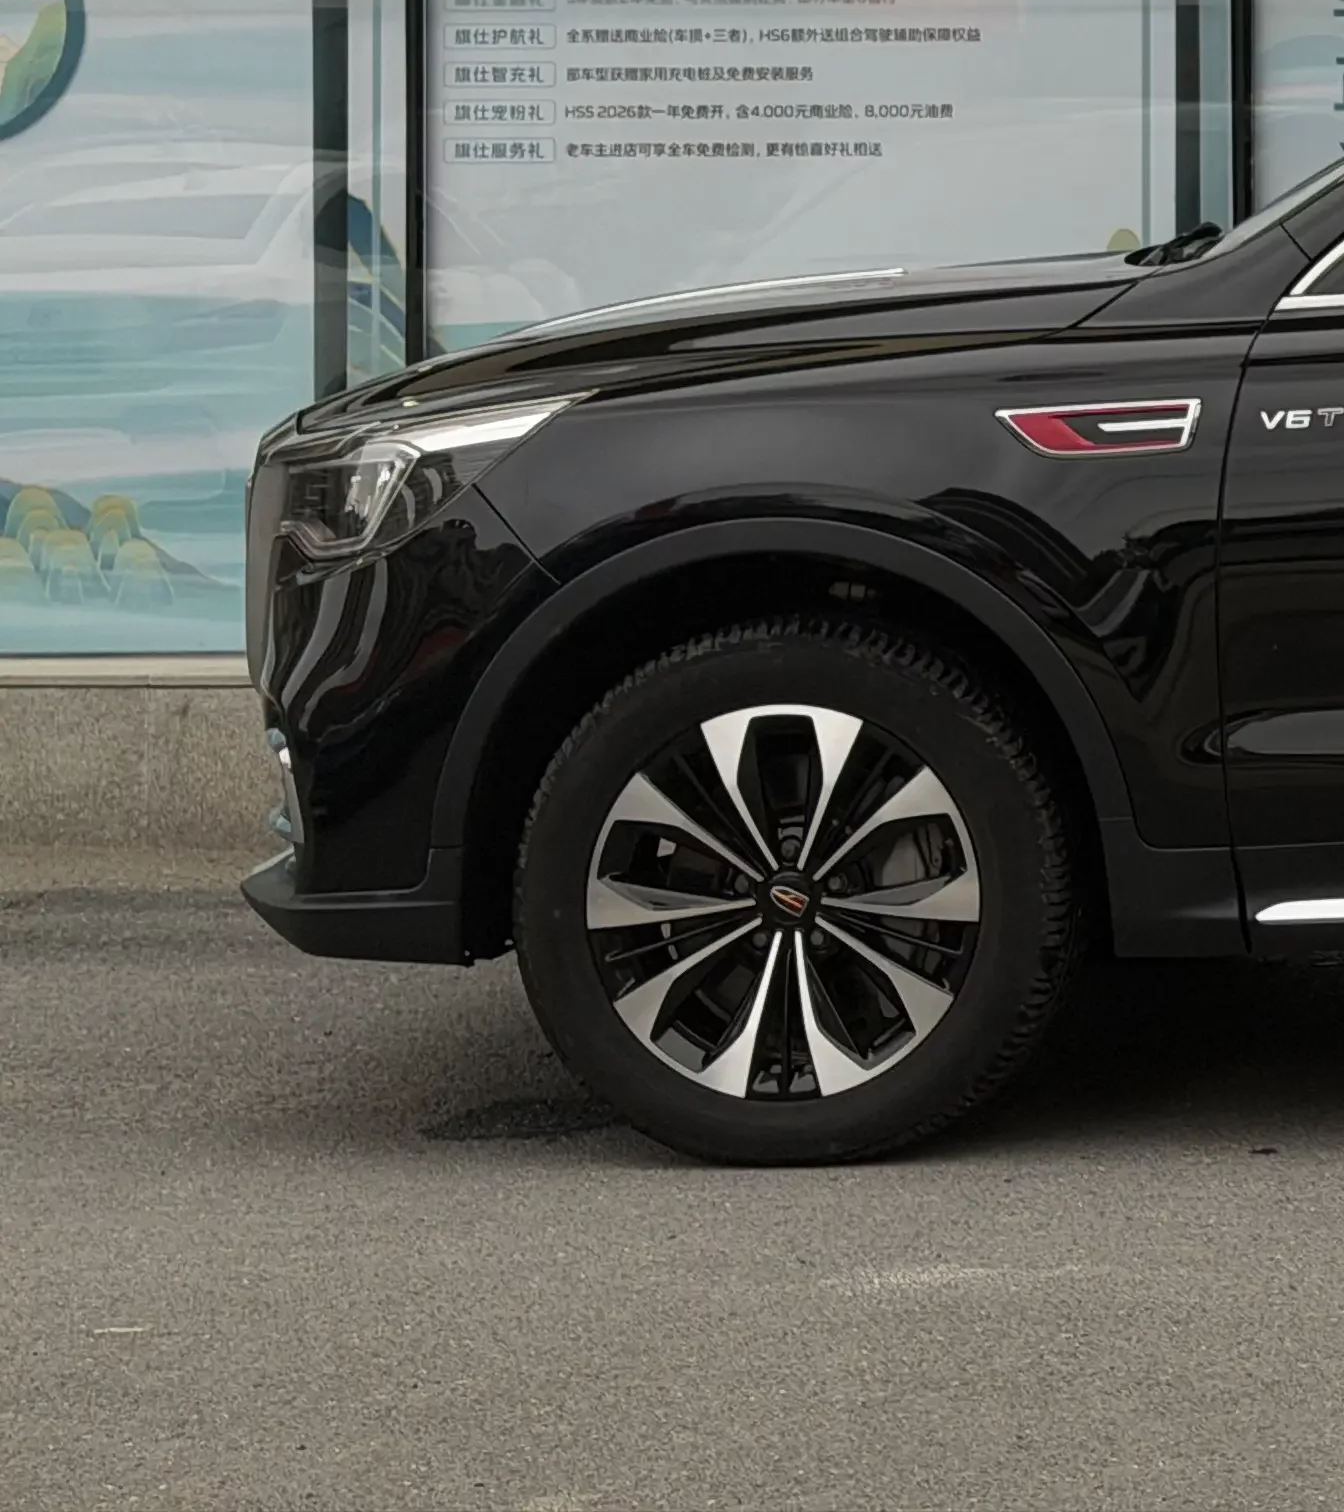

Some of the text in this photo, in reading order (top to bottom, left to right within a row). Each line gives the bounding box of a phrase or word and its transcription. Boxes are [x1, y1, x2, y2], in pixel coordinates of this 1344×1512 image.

[454, 142, 545, 160] 旗仕服务礼
